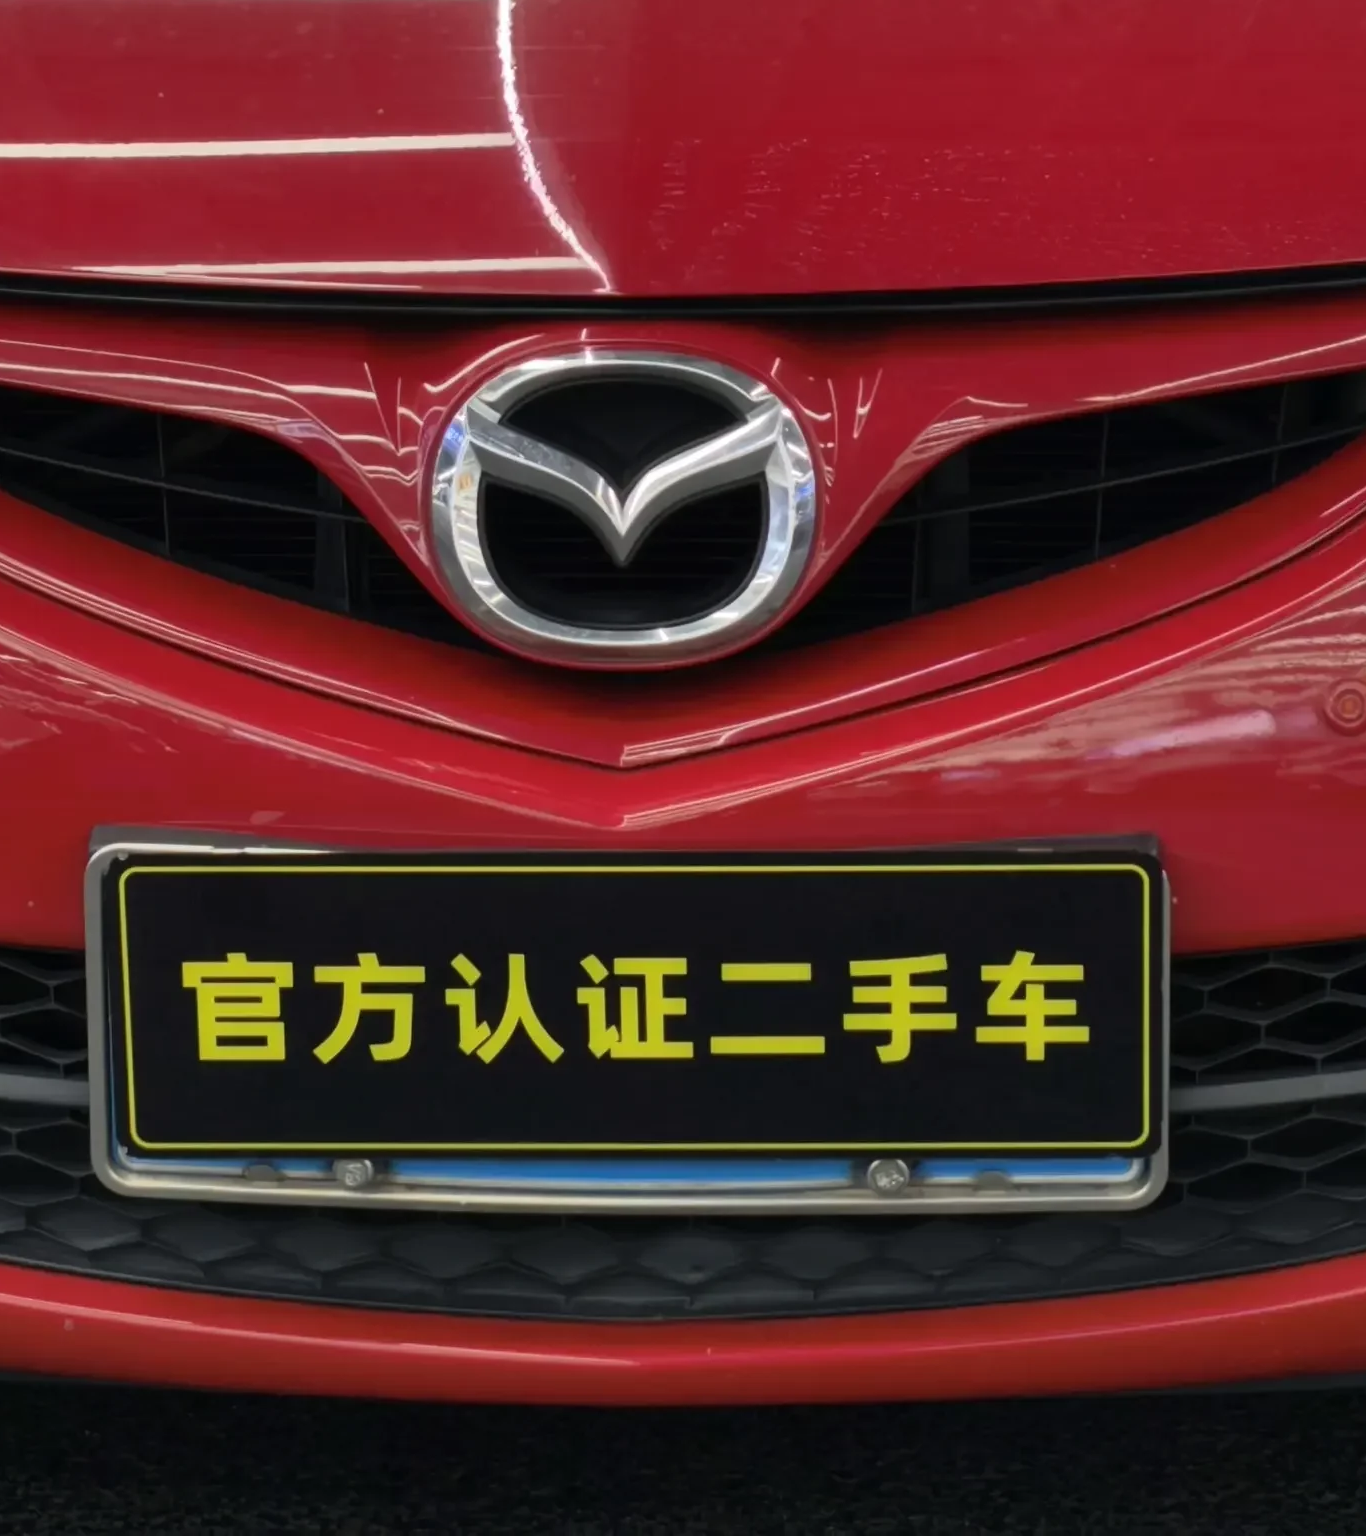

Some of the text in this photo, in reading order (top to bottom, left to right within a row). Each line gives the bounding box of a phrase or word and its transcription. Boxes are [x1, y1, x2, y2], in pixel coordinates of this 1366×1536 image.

[183, 951, 1089, 1063] 官方认证二手车
